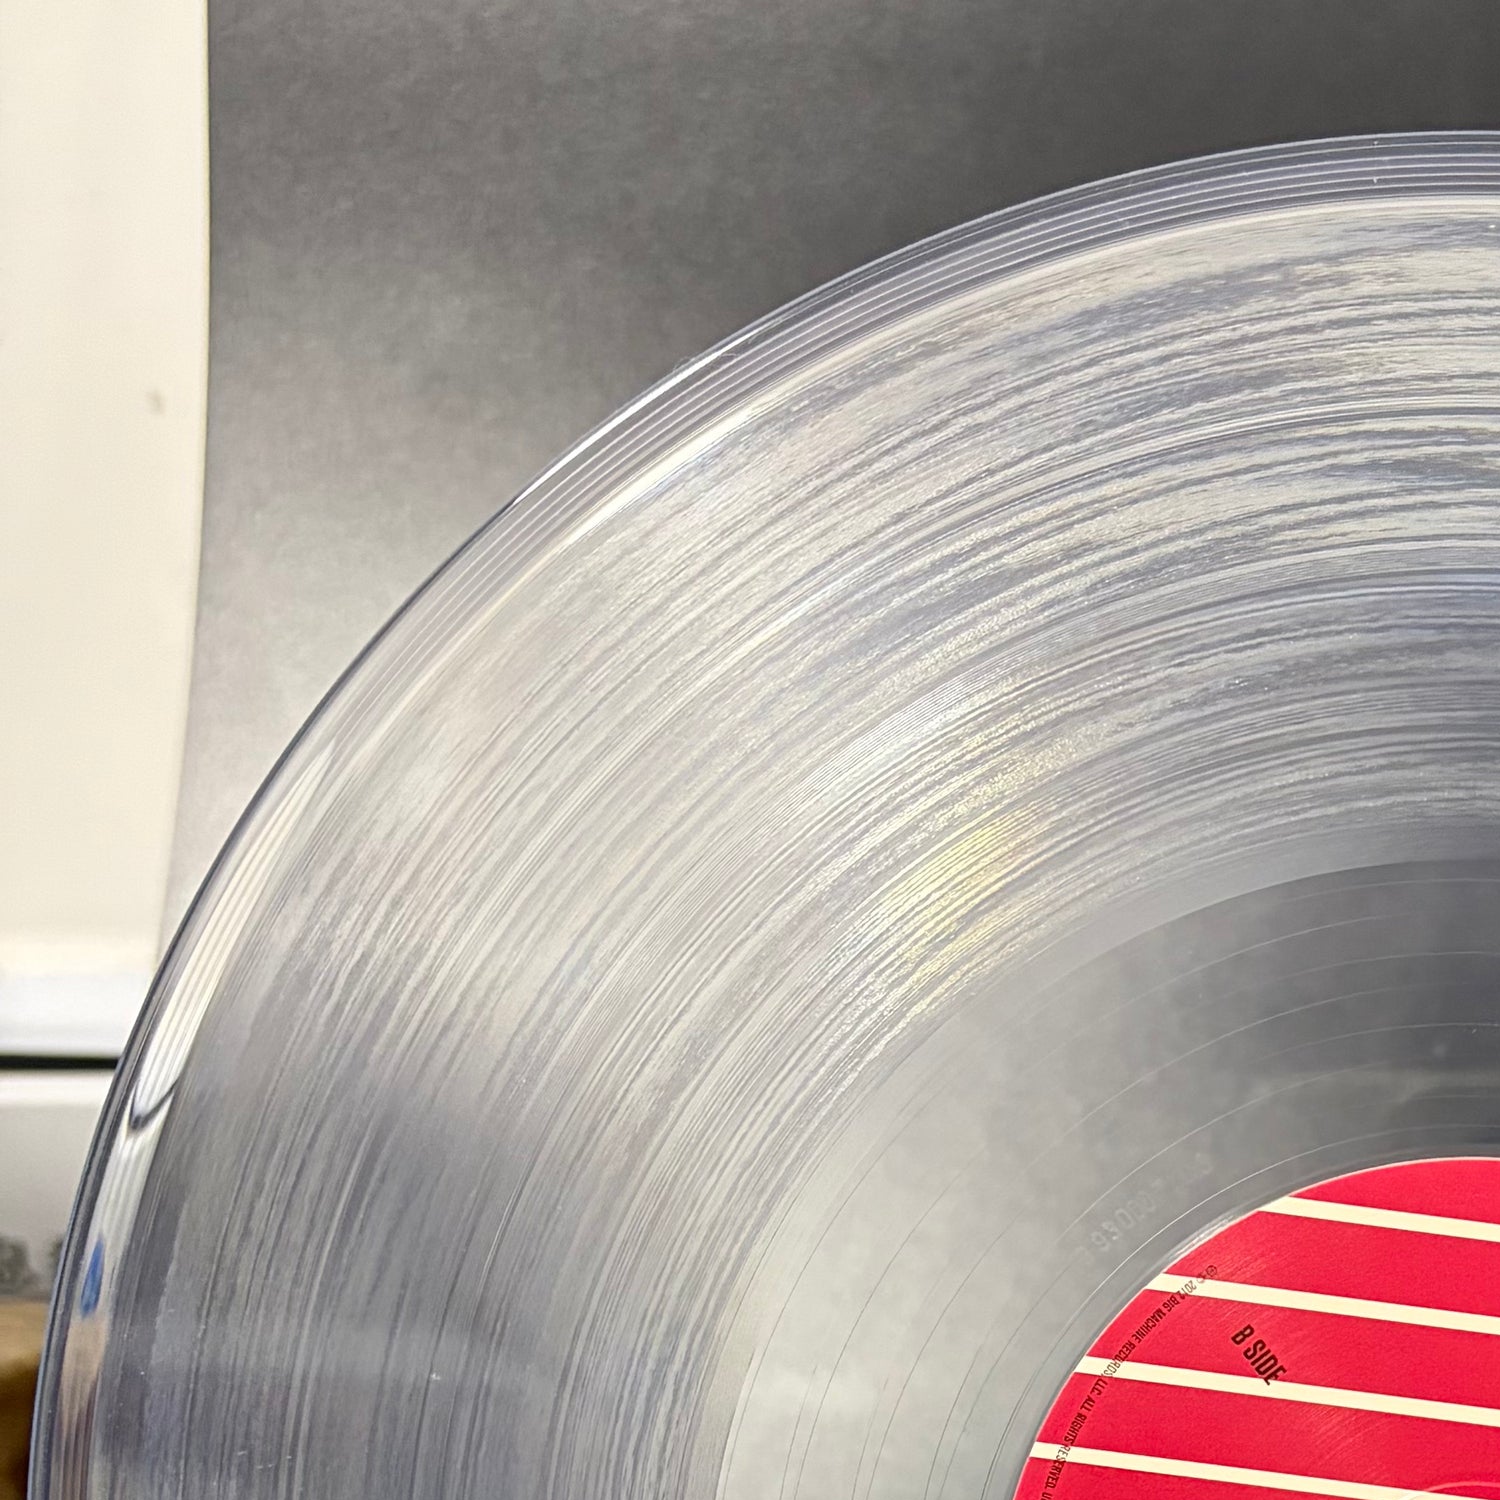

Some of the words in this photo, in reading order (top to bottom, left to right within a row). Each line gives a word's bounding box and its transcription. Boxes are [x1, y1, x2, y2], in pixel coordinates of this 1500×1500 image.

[1130, 1307, 1167, 1344] MACHINE
[1099, 1339, 1136, 1379] RECORDS,
[1231, 1324, 1255, 1345] B
[1243, 1339, 1287, 1386] SIDE
[1062, 1411, 1087, 1447] RIGHTS
